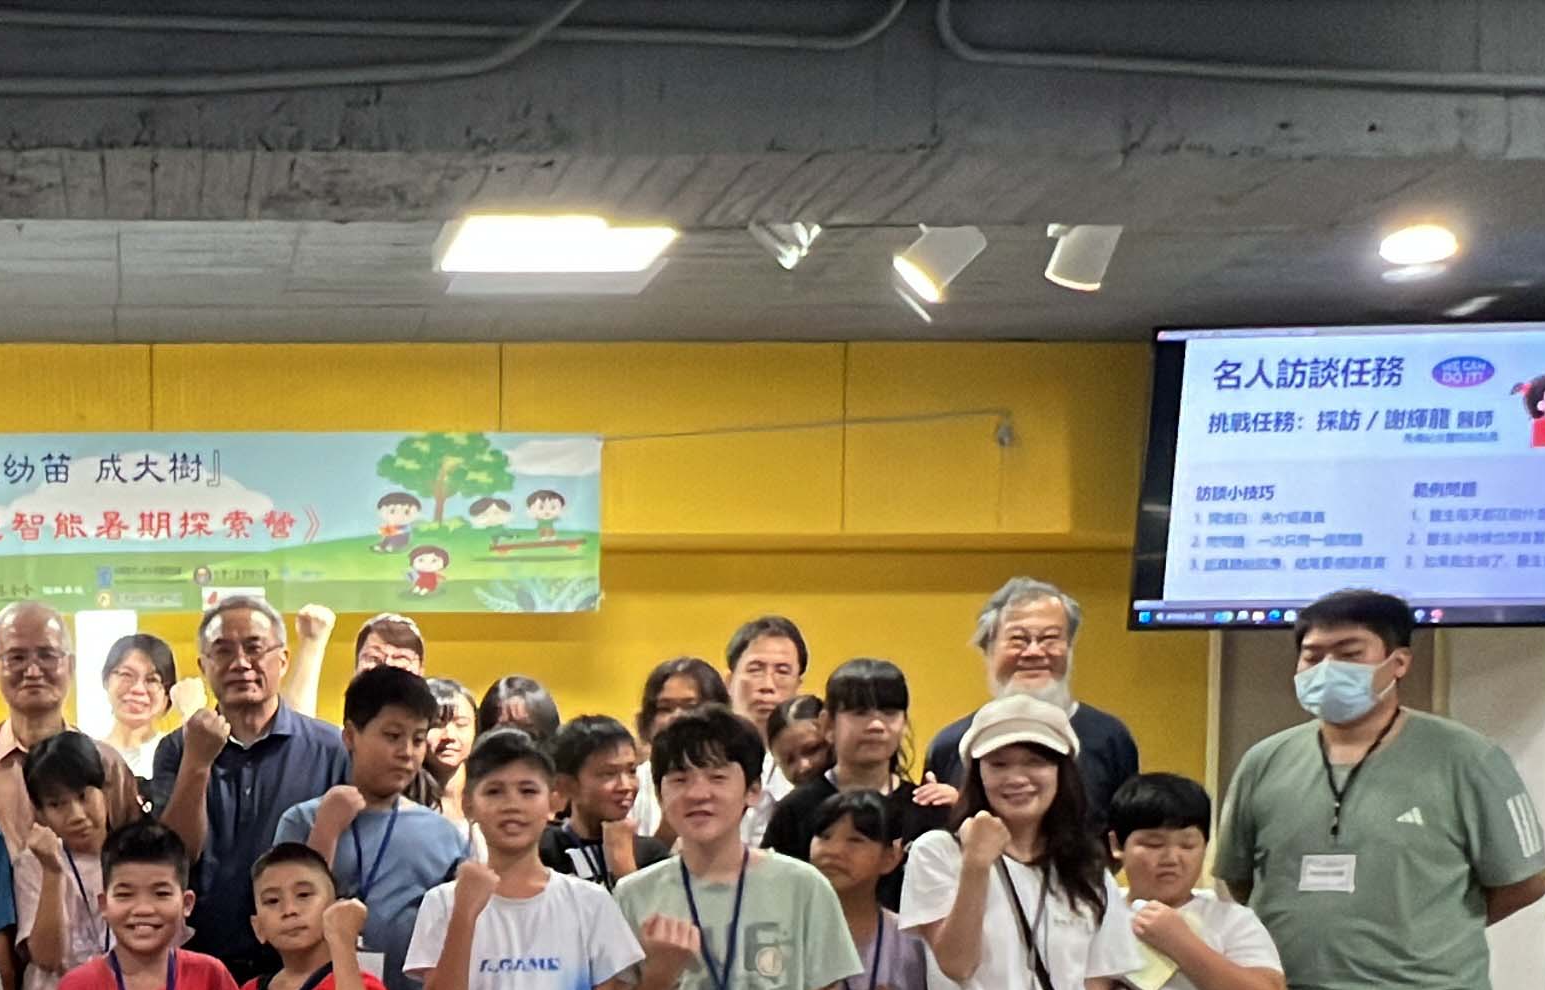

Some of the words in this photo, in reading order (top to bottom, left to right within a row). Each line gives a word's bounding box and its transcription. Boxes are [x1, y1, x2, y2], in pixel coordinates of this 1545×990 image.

[1213, 356, 1405, 390] 名人訪談任務
[1441, 371, 1463, 383] DO
